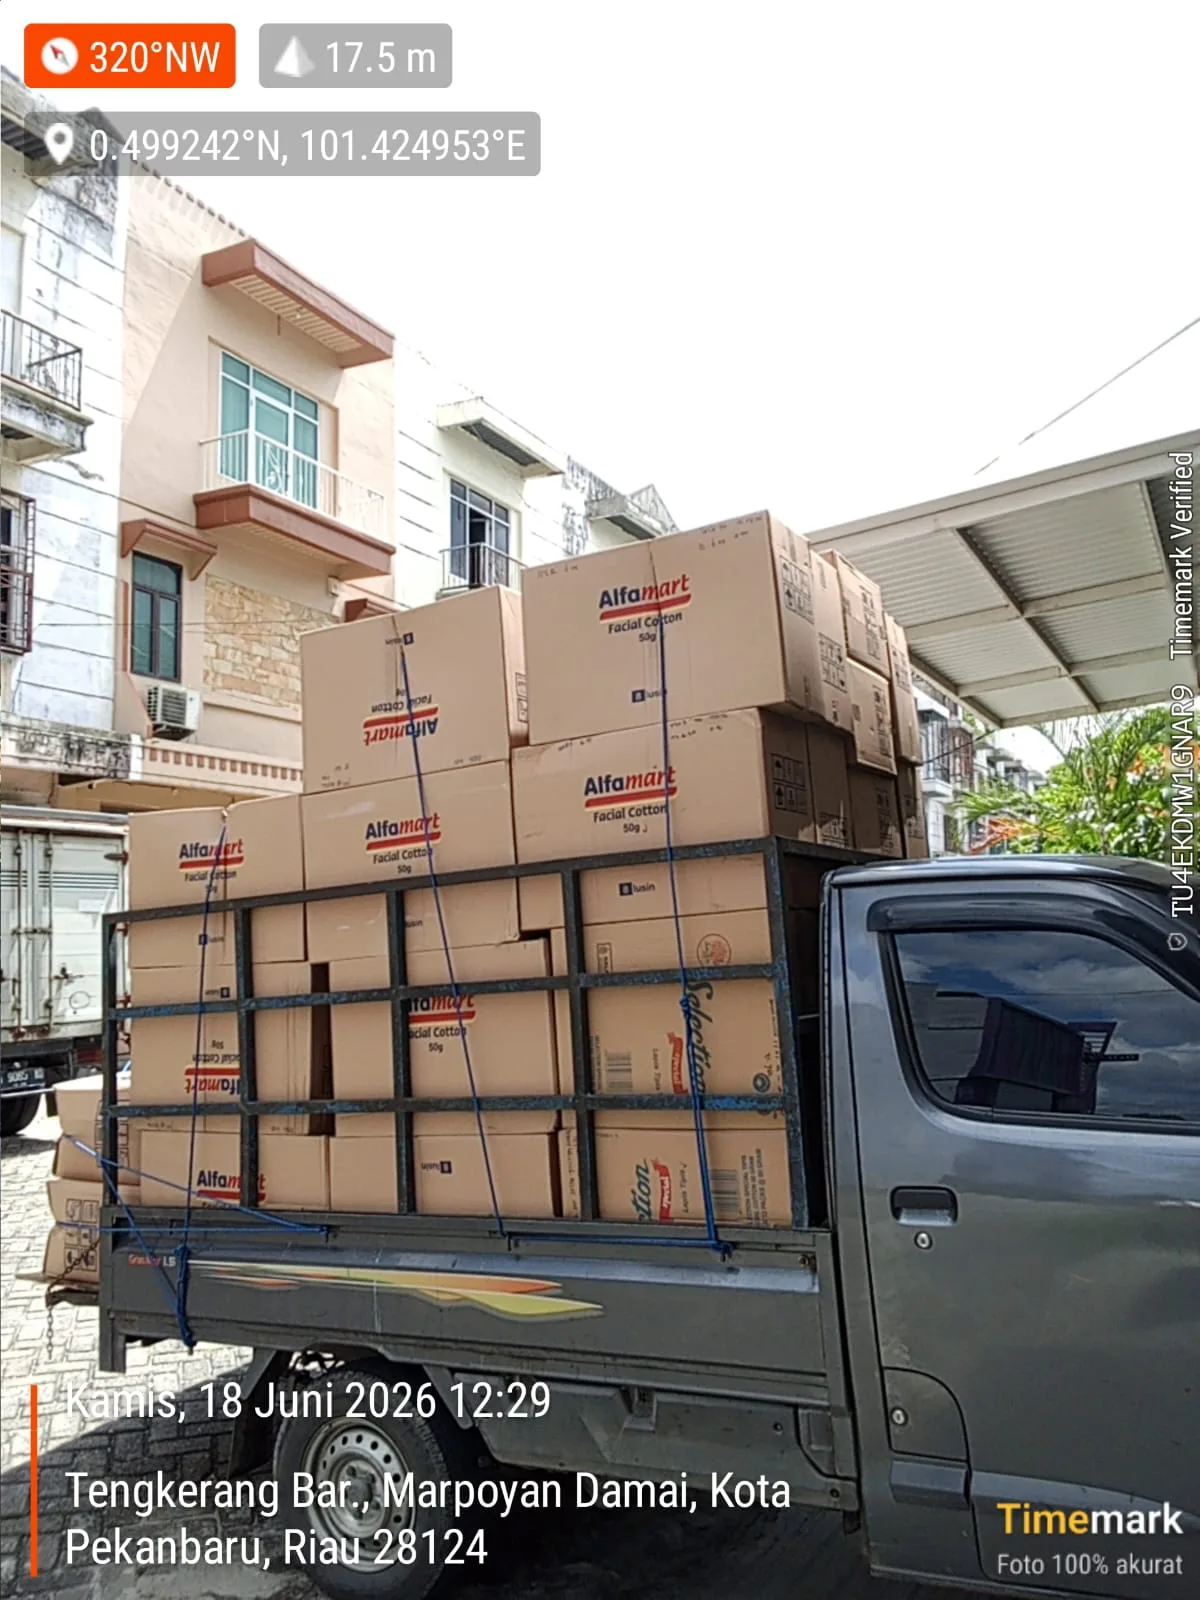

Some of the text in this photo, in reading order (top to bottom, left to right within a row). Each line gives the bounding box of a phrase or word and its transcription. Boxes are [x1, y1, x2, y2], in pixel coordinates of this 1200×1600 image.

[599, 573, 690, 609] Alfamart
[608, 618, 642, 634] Facial
[584, 766, 677, 797] Alfamart
[593, 808, 626, 823] Facial
[366, 812, 441, 840] Alfamart
[373, 850, 400, 864] Facial
[184, 1078, 240, 1095] lfamart
[197, 1169, 266, 1190] Alfamt
